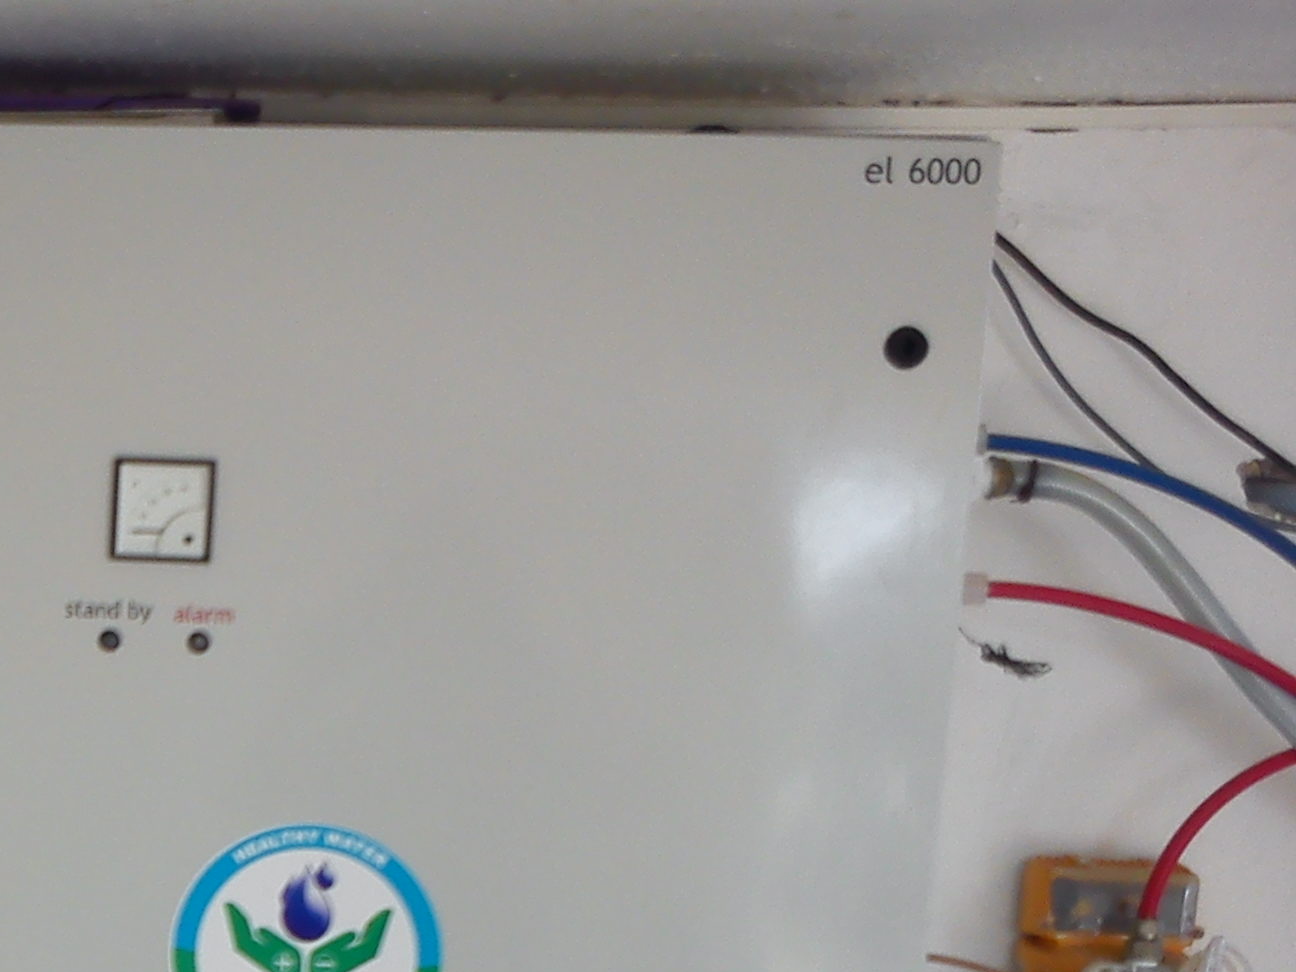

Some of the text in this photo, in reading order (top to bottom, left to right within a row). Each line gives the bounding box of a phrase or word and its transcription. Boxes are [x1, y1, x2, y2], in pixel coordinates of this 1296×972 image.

[865, 156, 981, 185] el 6000
[64, 601, 152, 625] stand by
[174, 605, 236, 624] alarm
